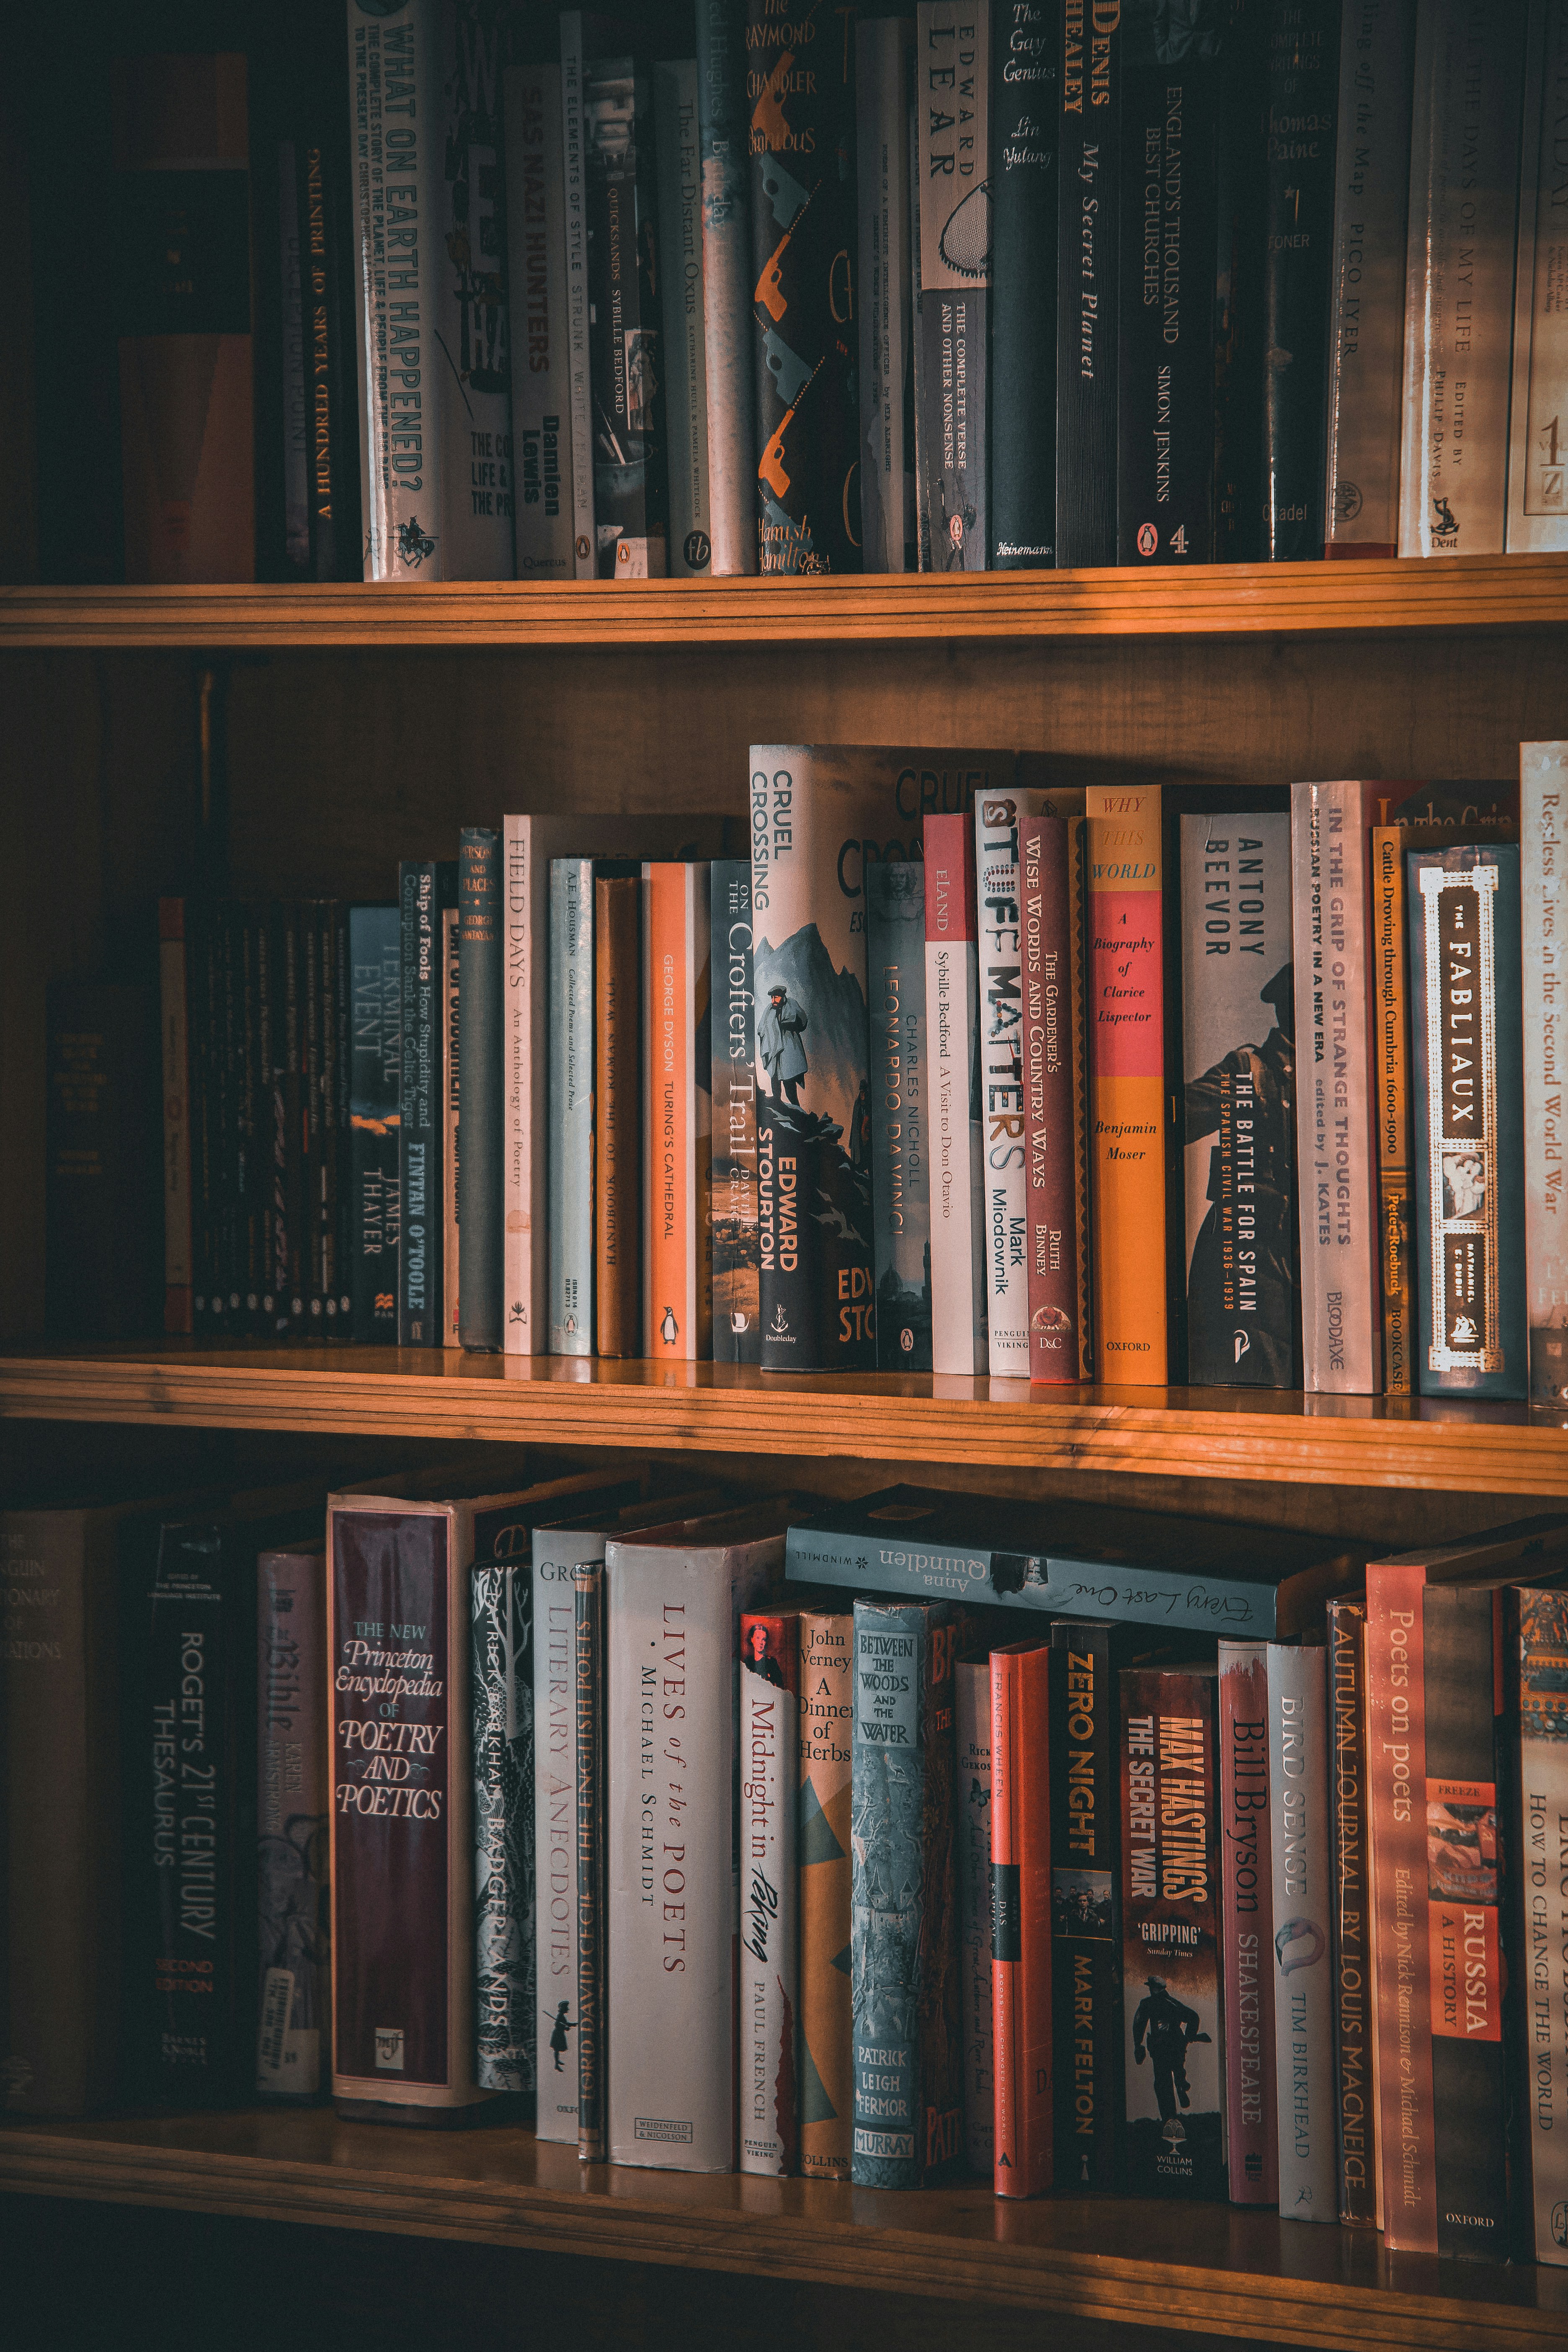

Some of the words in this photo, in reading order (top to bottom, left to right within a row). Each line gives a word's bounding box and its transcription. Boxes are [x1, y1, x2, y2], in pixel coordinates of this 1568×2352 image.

[384, 23, 416, 117] WHAT
[567, 56, 577, 88] THE
[677, 101, 695, 137] The
[930, 26, 955, 178] LEAR
[960, 24, 975, 176] EDWARD
[386, 129, 417, 172] ON
[567, 97, 580, 184] ELEMENTS
[679, 146, 696, 178] Far
[1077, 142, 1099, 183] My
[1145, 126, 1161, 178] BEST
[1165, 85, 1183, 211] ENGLAND'S
[570, 193, 580, 213] OF
[682, 184, 699, 256] Distant
[386, 185, 419, 289] EARTH
[571, 222, 582, 271] STYLE
[607, 188, 621, 281] QUICKSANDS
[1081, 197, 1099, 280] Secret
[1143, 183, 1161, 305] CHURCHES
[684, 261, 701, 314] Oxus
[1163, 215, 1181, 344] THOUSAND
[611, 289, 624, 344] SYBILLE
[941, 303, 952, 335] AND
[956, 302, 966, 335] THE
[1081, 294, 1098, 379] Planet
[613, 348, 626, 415] BEDFORD
[942, 337, 953, 388] OTHER
[956, 338, 967, 416] COMPLETE
[389, 301, 423, 491] HAPPENED?
[1156, 366, 1171, 423] SIMON
[943, 393, 954, 469] NONSENSE
[957, 420, 967, 469] VERSE
[522, 430, 542, 504] Lewis
[543, 415, 561, 516] Damien
[1153, 429, 1171, 502] JENKINS
[1431, 537, 1459, 549] Dent
[752, 771, 770, 910] CROSSING
[773, 769, 793, 861] CRUEL
[509, 838, 525, 913] FIELD
[568, 872, 577, 895] A.E.
[1381, 841, 1395, 883] Cattle
[416, 874, 432, 911] Ship
[1204, 838, 1231, 956] BEEVOR
[1238, 837, 1265, 957] ANTONY
[1381, 887, 1396, 946] Droving
[419, 914, 432, 931] of
[568, 900, 578, 957] HOUSMAN
[1092, 936, 1155, 954] Biography
[1117, 913, 1128, 925] A
[419, 935, 432, 981] Fools
[509, 923, 525, 988] DAYS
[936, 951, 950, 998] Sybille
[1117, 961, 1133, 977] of
[1382, 948, 1398, 1007] through
[419, 985, 432, 1016] How
[567, 968, 577, 1006] Collected
[663, 954, 674, 1016] GEORGE
[1102, 985, 1146, 999] Clarice
[512, 1008, 524, 1028] An
[568, 1009, 577, 1033] Poems
[568, 1035, 577, 1051] and
[883, 965, 902, 1110] LEONARDO
[939, 1003, 952, 1058] Bedford
[1096, 1010, 1152, 1025] Lispector
[1385, 1010, 1398, 1075] Cumbria
[1449, 941, 1474, 1123] FABLIAUX
[416, 1019, 433, 1094] Stupidity
[567, 1055, 577, 1088] Selected
[663, 1020, 674, 1072] DYSON
[940, 1066, 951, 1078] A
[509, 1035, 524, 1112] Anthology
[940, 1080, 952, 1112] Visit
[1220, 1073, 1230, 1096] THE
[1235, 1070, 1254, 1109] THE
[419, 1098, 432, 1128] and
[567, 1090, 576, 1111] Prose
[663, 1081, 674, 1148] TURING'S
[941, 1116, 951, 1132] to
[513, 1119, 524, 1135] of
[887, 1124, 902, 1158] DA
[941, 1135, 953, 1167] Don
[1093, 1119, 1158, 1139] Benjamin
[1220, 1103, 1232, 1158] SPANISH
[407, 1142, 426, 1217] FINTAN
[510, 1142, 524, 1189] Poetry
[1105, 1146, 1146, 1161] Moser
[1235, 1119, 1255, 1194] BATTLE
[663, 1153, 674, 1240] CATHEDRAL
[758, 1126, 775, 1271] STOURTON
[889, 1164, 903, 1235] VINCI
[942, 1171, 954, 1219] Otavio
[1221, 1166, 1232, 1199] CIVIL
[777, 1157, 798, 1272] EDWARD
[1222, 1207, 1233, 1232] WAR
[1238, 1204, 1256, 1241] FOR
[407, 1225, 426, 1310] O'TOOLE
[991, 1188, 1010, 1295] Miodownik
[1008, 1216, 1028, 1267] Mark
[1034, 1223, 1048, 1277] BINNEY
[1048, 1229, 1063, 1271] RUTH
[1238, 1250, 1257, 1311] SPAIN
[344, 1640, 434, 1671] Princeton
[662, 1602, 686, 1720] LIVES
[859, 1633, 913, 1658] BETWEEN
[872, 1658, 895, 1673] THE
[1389, 1609, 1415, 1688] Poets
[335, 1665, 443, 1704] Encyclopedia
[548, 1606, 573, 1758] LITERARY
[859, 1673, 910, 1692] WOODS
[873, 1695, 897, 1706] AND
[1066, 1651, 1093, 1741] ZERO
[379, 1702, 400, 1718] OF
[641, 1664, 657, 1781] MICHAEL
[859, 1722, 911, 1745] WATER
[873, 1707, 894, 1719] THE
[1127, 1716, 1154, 1756] THE
[1391, 1695, 1410, 1735] on
[338, 1719, 444, 1755] POETRY
[663, 1737, 687, 1769] of
[743, 1698, 776, 1828] Midnight
[1159, 1716, 1204, 1774] MAX
[1233, 1717, 1266, 1779] Bill
[1281, 1696, 1305, 1779] BIRD
[361, 1755, 411, 1782] AND
[1382, 1743, 1413, 1823] poets
[335, 1783, 442, 1820] POETICS
[668, 1782, 687, 1827] the
[1068, 1750, 1094, 1857] NIGHT
[1129, 1761, 1155, 1843] SECRET
[641, 1793, 657, 1908] SCHMIDT
[750, 1833, 774, 1859] in
[1161, 1778, 1208, 1903] HASTINGS
[1226, 1786, 1267, 1914] Bryson
[1282, 1790, 1307, 1897] SENSE
[549, 1770, 575, 1976] ANECDOTES
[1130, 1847, 1157, 1898] WAR
[663, 1841, 686, 1974] POETS
[740, 1861, 779, 1964] Peking
[753, 1981, 766, 2034] PAUL
[1073, 1954, 1092, 2031] MARK
[1291, 1992, 1307, 2033] TIM
[1237, 1932, 1262, 2126] SHAKESPEARE
[753, 2039, 766, 2122] FRENCH
[858, 2045, 908, 2067] PATRICK
[861, 2071, 901, 2092] LEIGH
[860, 2095, 908, 2117] FERMOR
[1075, 2037, 1093, 2135] FELTON
[1292, 2041, 1310, 2159] BIRKHEAD
[856, 2130, 912, 2156] MURRAY
[1156, 2156, 1192, 2166] WILLIAM
[1157, 2165, 1193, 2176] COLLINS
